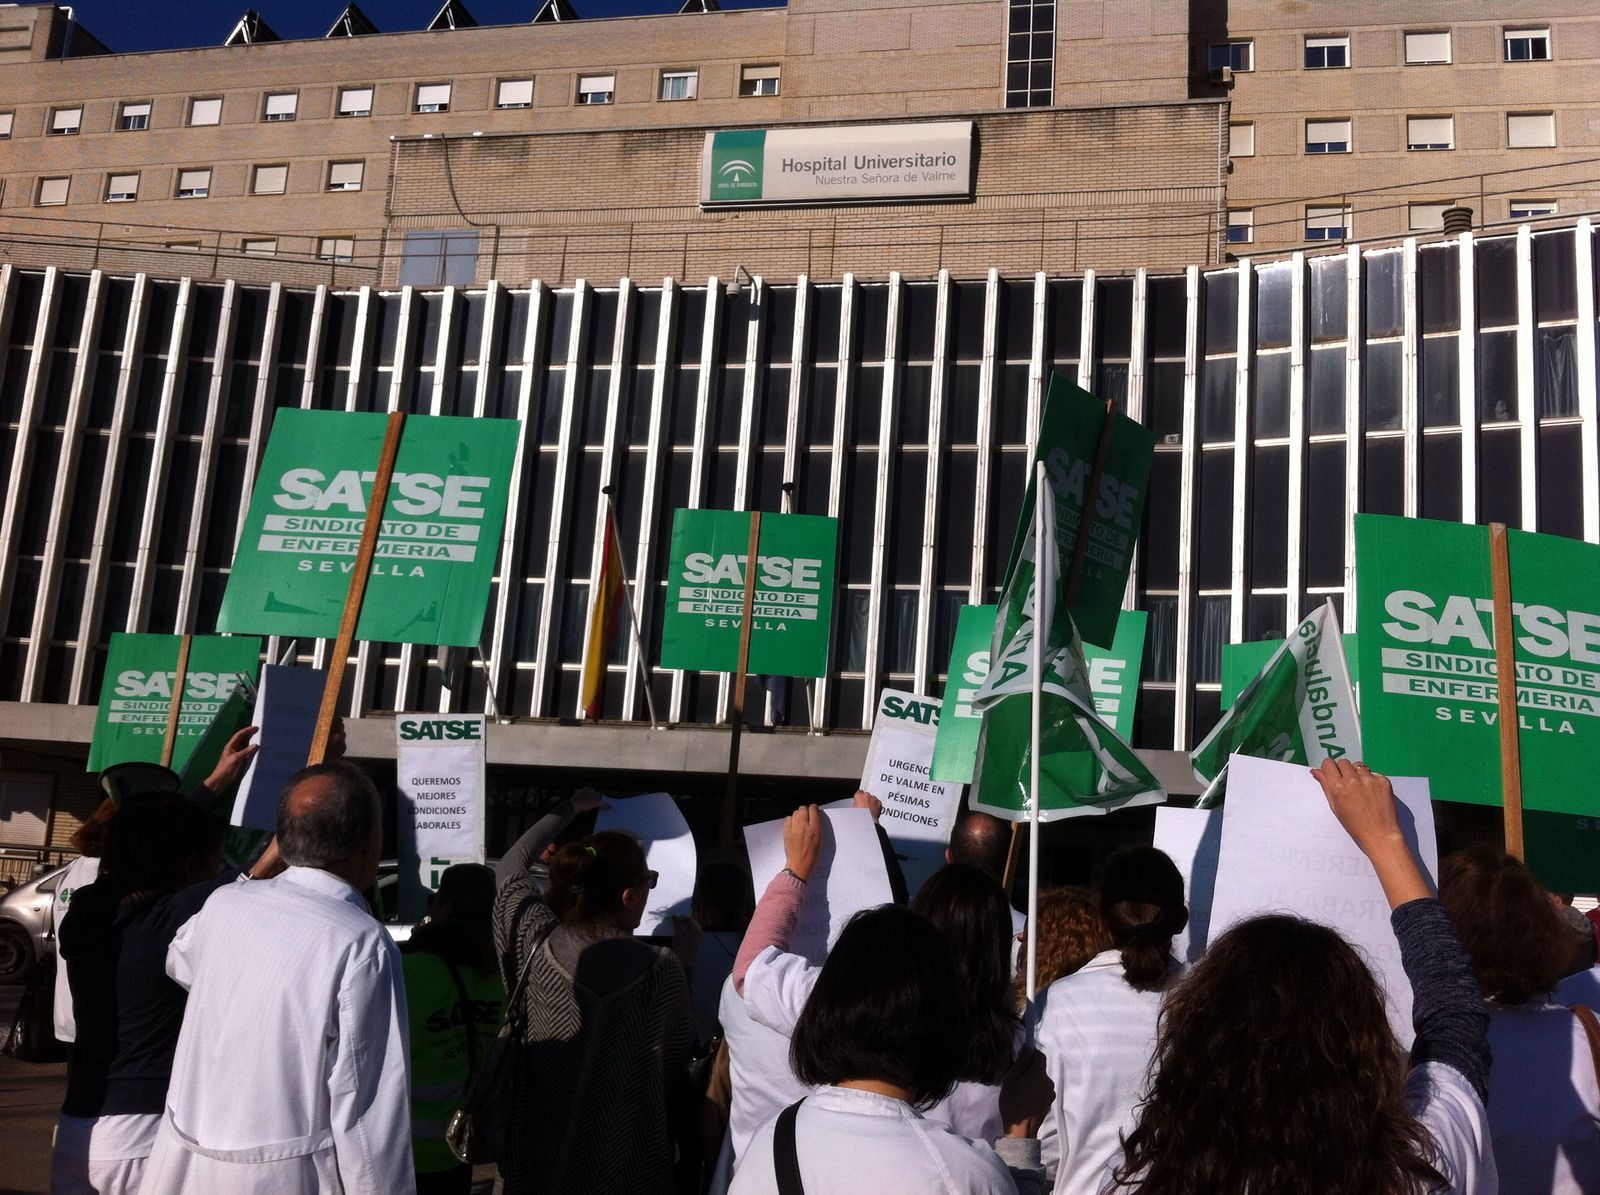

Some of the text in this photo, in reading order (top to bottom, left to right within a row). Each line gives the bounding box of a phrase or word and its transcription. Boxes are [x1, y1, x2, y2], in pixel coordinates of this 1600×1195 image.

[782, 152, 956, 175] Hospital Universitario
[815, 171, 956, 185] Nuestra Señora de Valme
[1048, 447, 1138, 530] SASE
[425, 525, 459, 538] DE
[298, 559, 425, 577] SEVLLA
[784, 593, 806, 603] DE
[705, 619, 787, 631] SEVLLA
[1562, 670, 1596, 689] DE
[122, 714, 213, 723] ENFERMERI
[1435, 707, 1575, 734] SEVLLA
[133, 727, 207, 736] SEVLL
[400, 720, 481, 740] SATSE
[889, 759, 932, 775] URGENCI
[411, 777, 461, 786] QUEREMOS
[880, 773, 945, 795] DE VALME EN
[417, 792, 456, 800] MEJORES
[888, 791, 930, 808] PÉSIMAS
[408, 806, 466, 815] CONDICIONES
[880, 807, 938, 827] ONDICIONES
[413, 821, 461, 830] LABORALES
